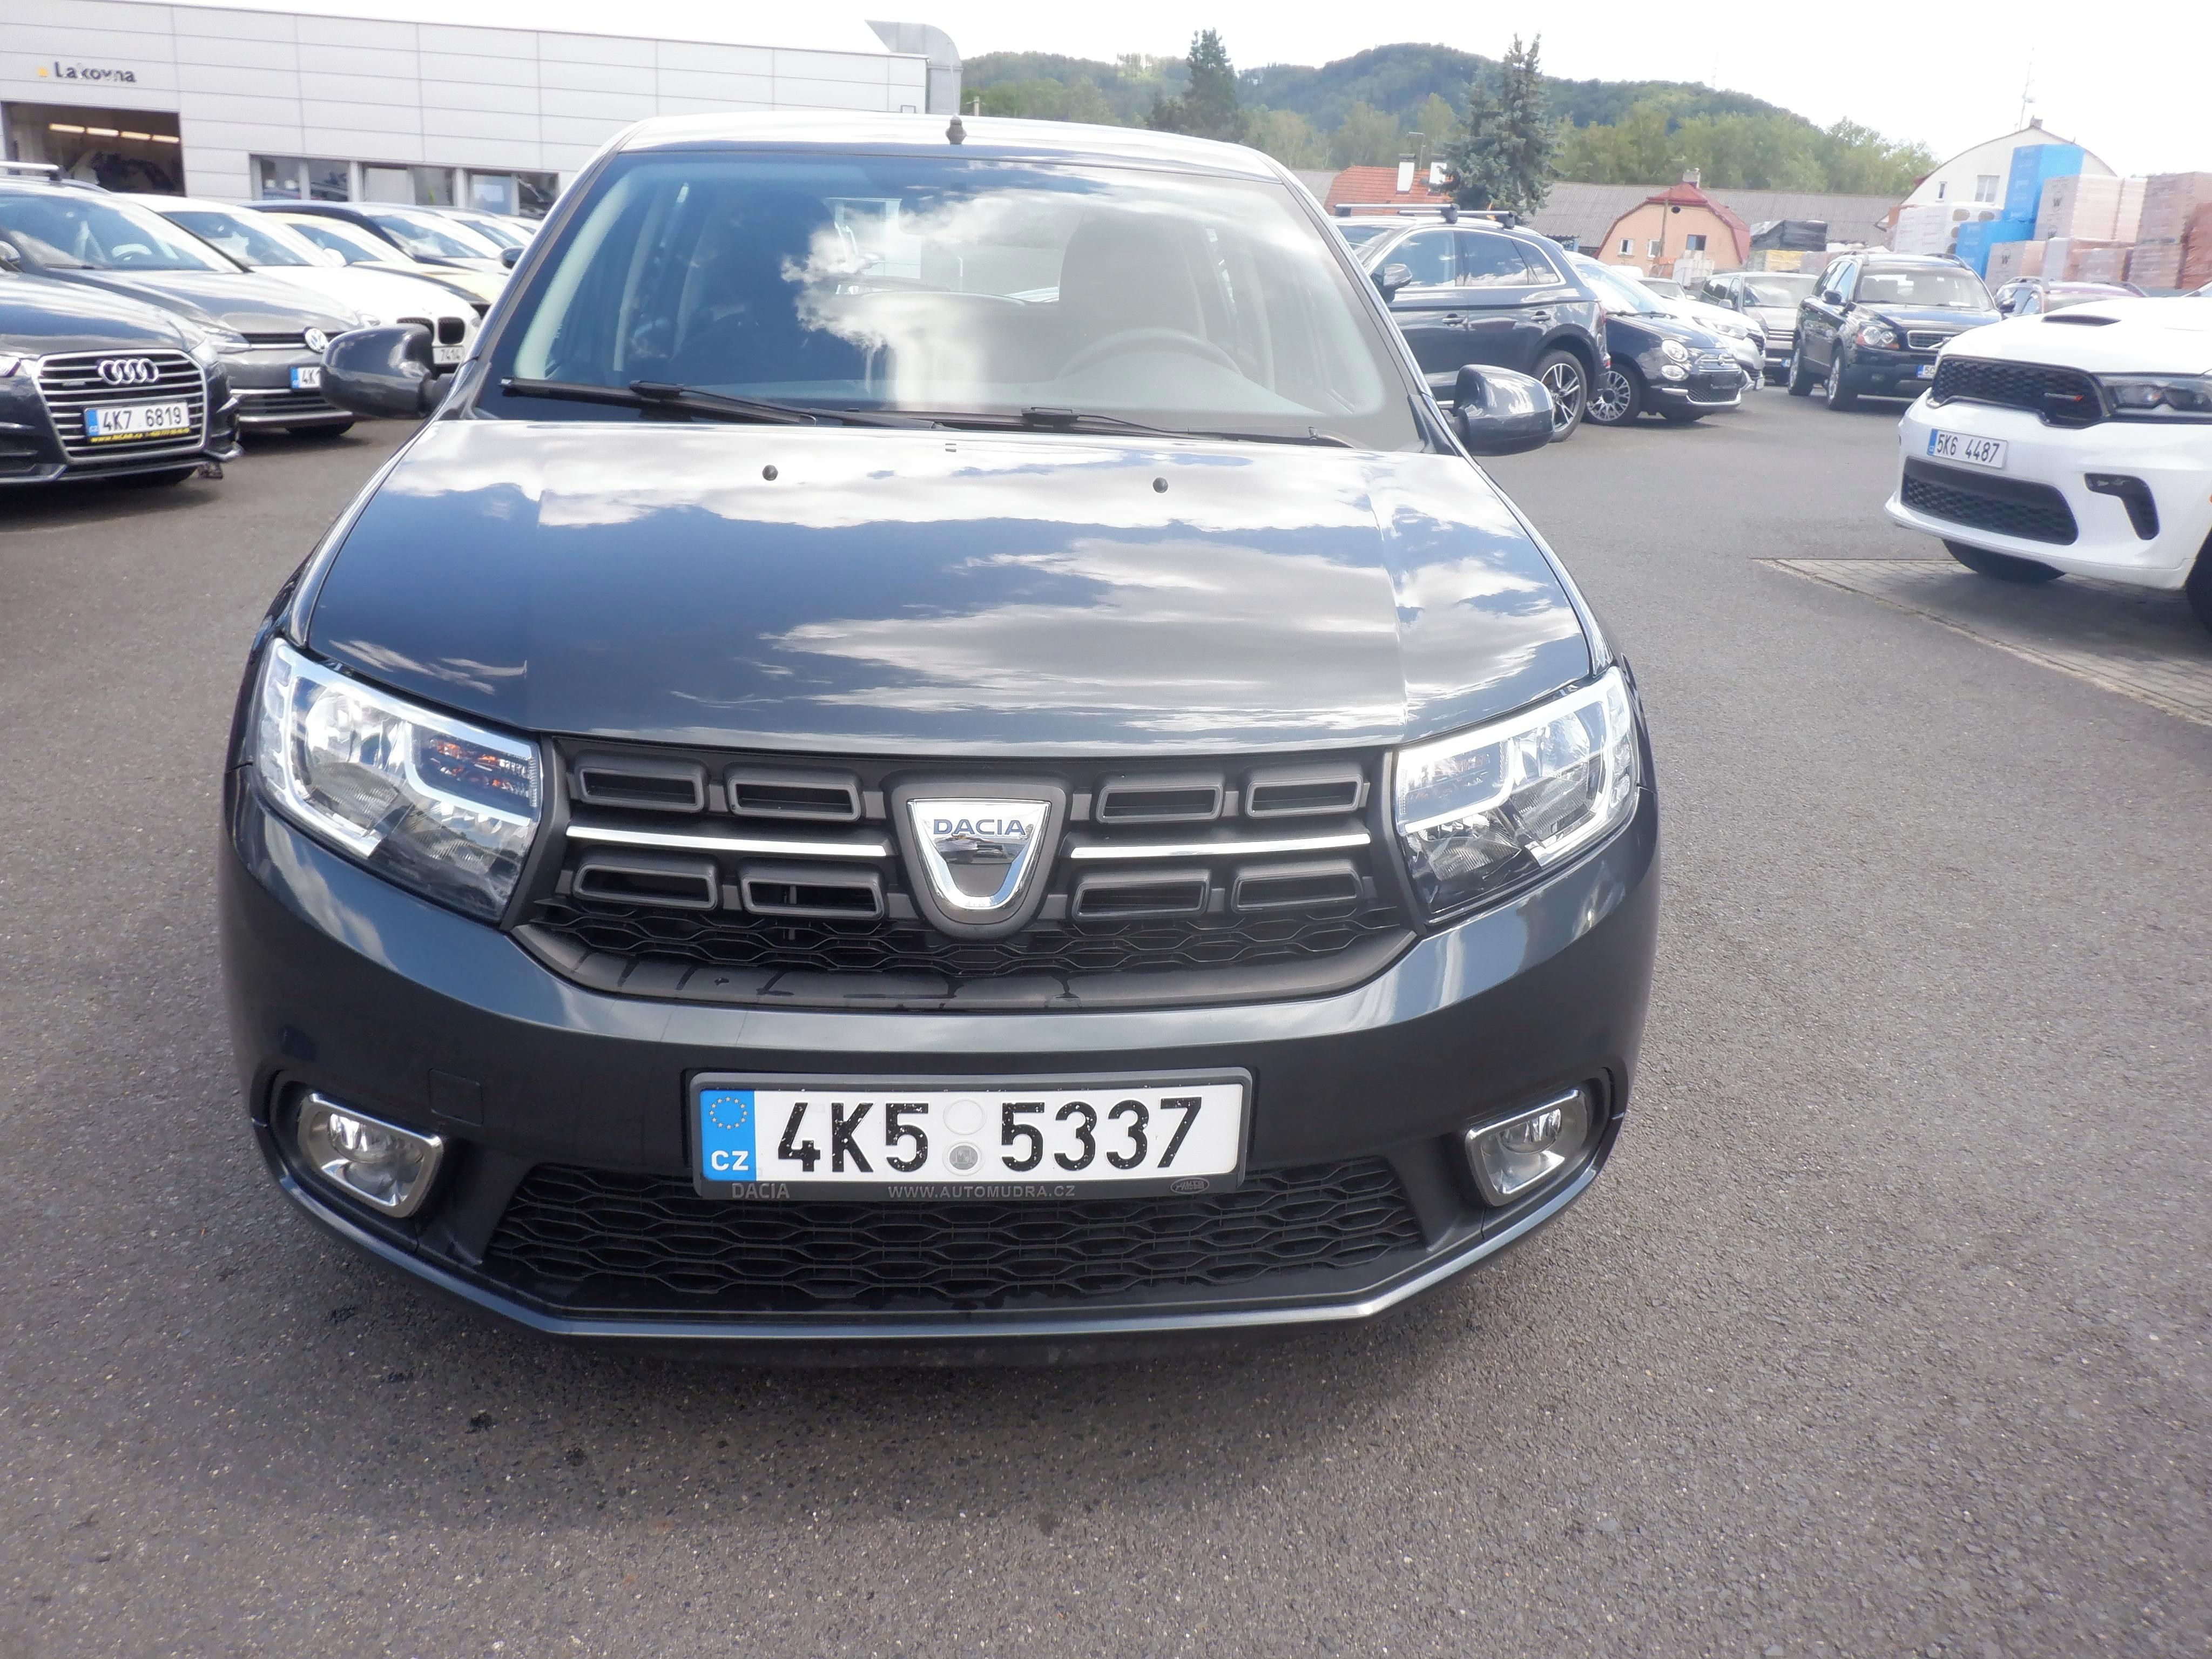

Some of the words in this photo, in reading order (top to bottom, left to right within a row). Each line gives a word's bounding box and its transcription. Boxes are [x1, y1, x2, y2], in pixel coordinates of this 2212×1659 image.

[53, 60, 137, 83] Lakovna
[103, 410, 132, 431] 4K7
[145, 406, 182, 427] 6819
[1937, 434, 1958, 455] 5K6
[1965, 439, 2000, 463] 4487
[933, 819, 1026, 836] DACIA
[778, 1102, 929, 1172] 4K5
[1001, 1096, 1202, 1172] 5337
[711, 1150, 749, 1171] CZ
[732, 1183, 790, 1199] DACIA
[888, 1185, 1076, 1198] WWW.AUTOMUDRA.CZ
